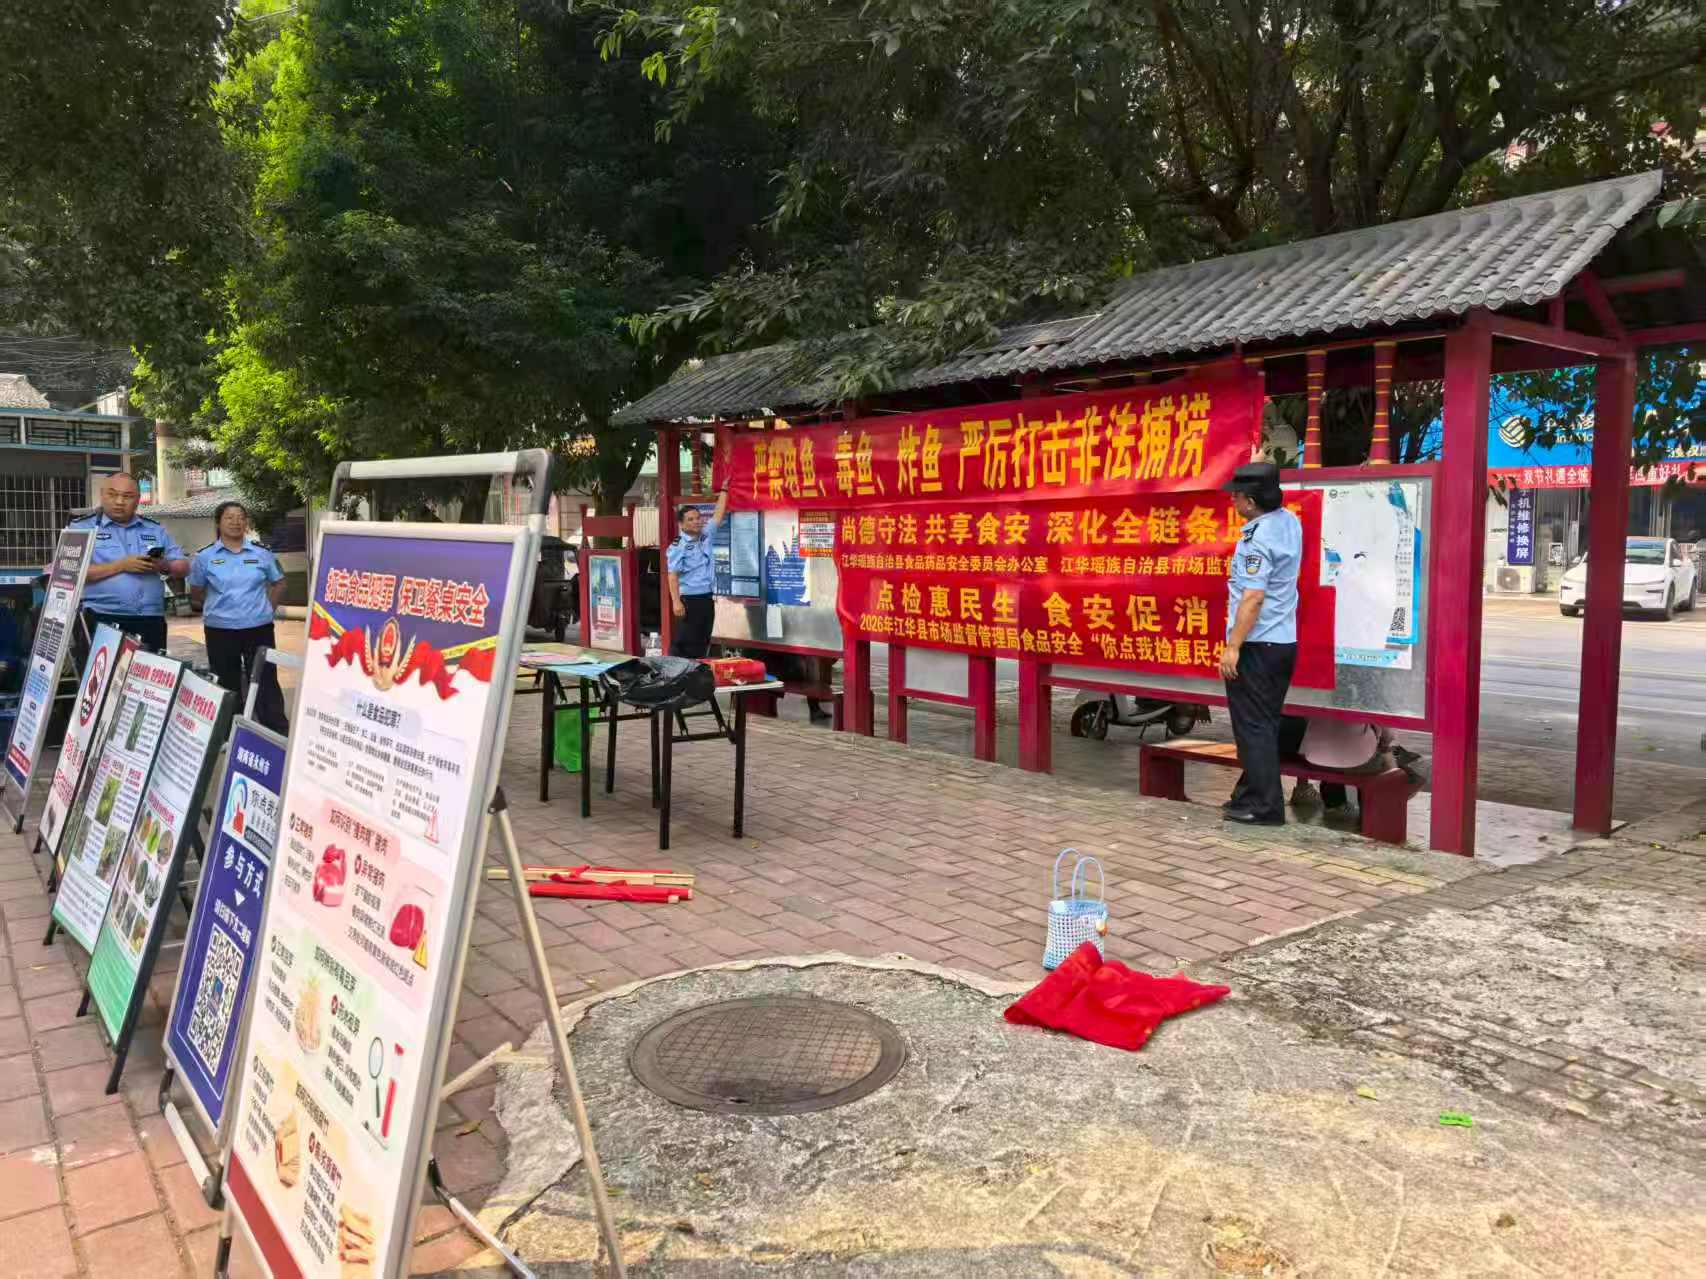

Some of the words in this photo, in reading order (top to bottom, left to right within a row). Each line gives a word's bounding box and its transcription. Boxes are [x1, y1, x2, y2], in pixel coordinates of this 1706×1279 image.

[958, 393, 1211, 491] 严厉打击非法捕捞
[841, 514, 918, 545] 尚德守法
[925, 512, 1030, 545] 共享食安
[876, 580, 1018, 624] 点检惠民生
[1043, 591, 1230, 635] 食安促消
[223, 844, 265, 899] 参与方式
